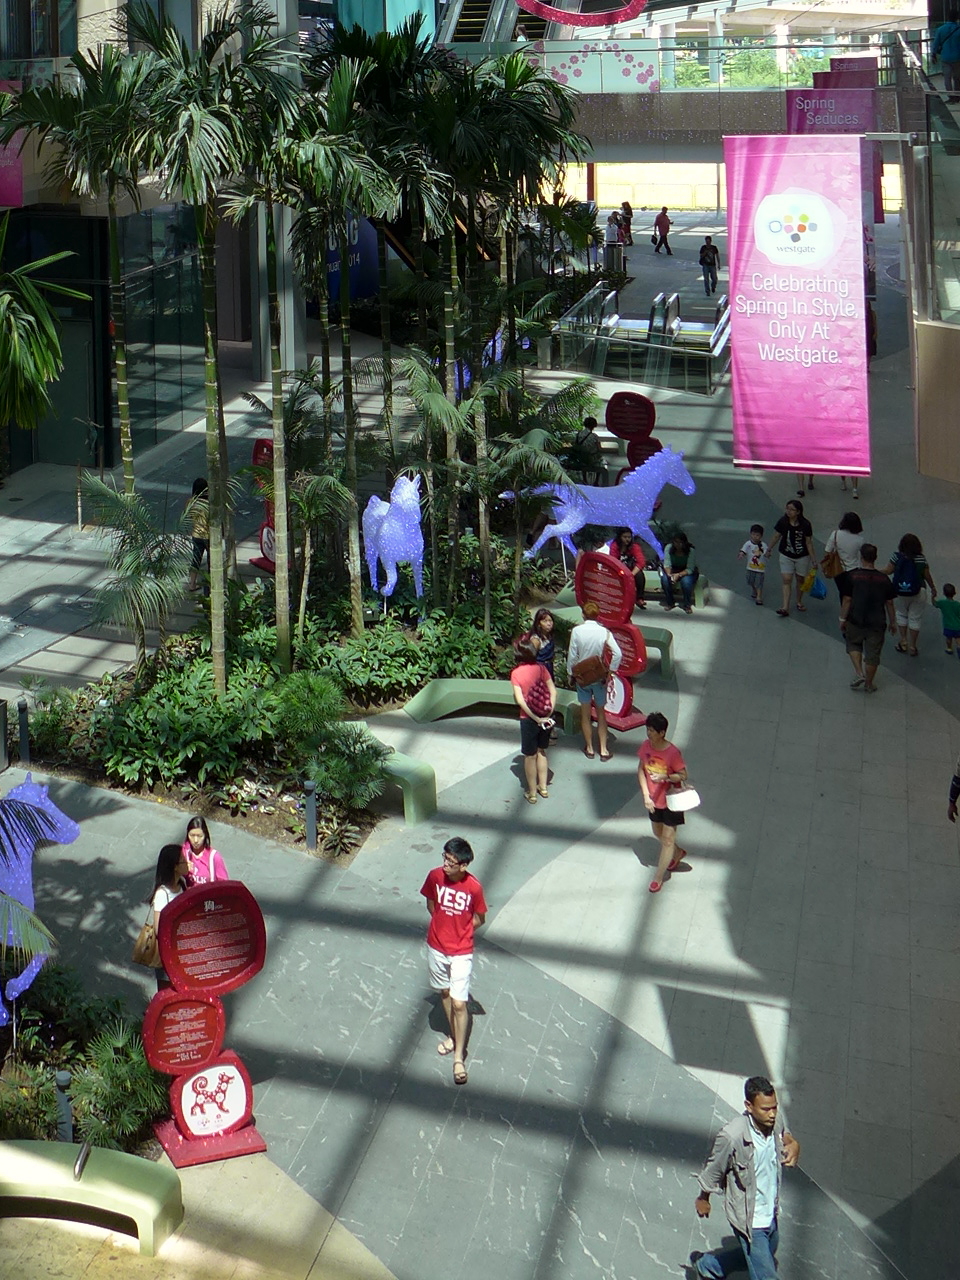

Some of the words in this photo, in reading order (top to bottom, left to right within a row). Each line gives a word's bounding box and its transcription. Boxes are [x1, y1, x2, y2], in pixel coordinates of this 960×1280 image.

[795, 96, 836, 112] Spring
[776, 245, 816, 254] westgate
[752, 272, 849, 298] Celebrating
[735, 295, 787, 320] Spring
[792, 297, 808, 316] In
[812, 298, 859, 321] Style,
[769, 321, 806, 343] Only
[811, 321, 830, 340] At
[758, 342, 842, 368] Westgate.
[435, 883, 472, 911] YES!
